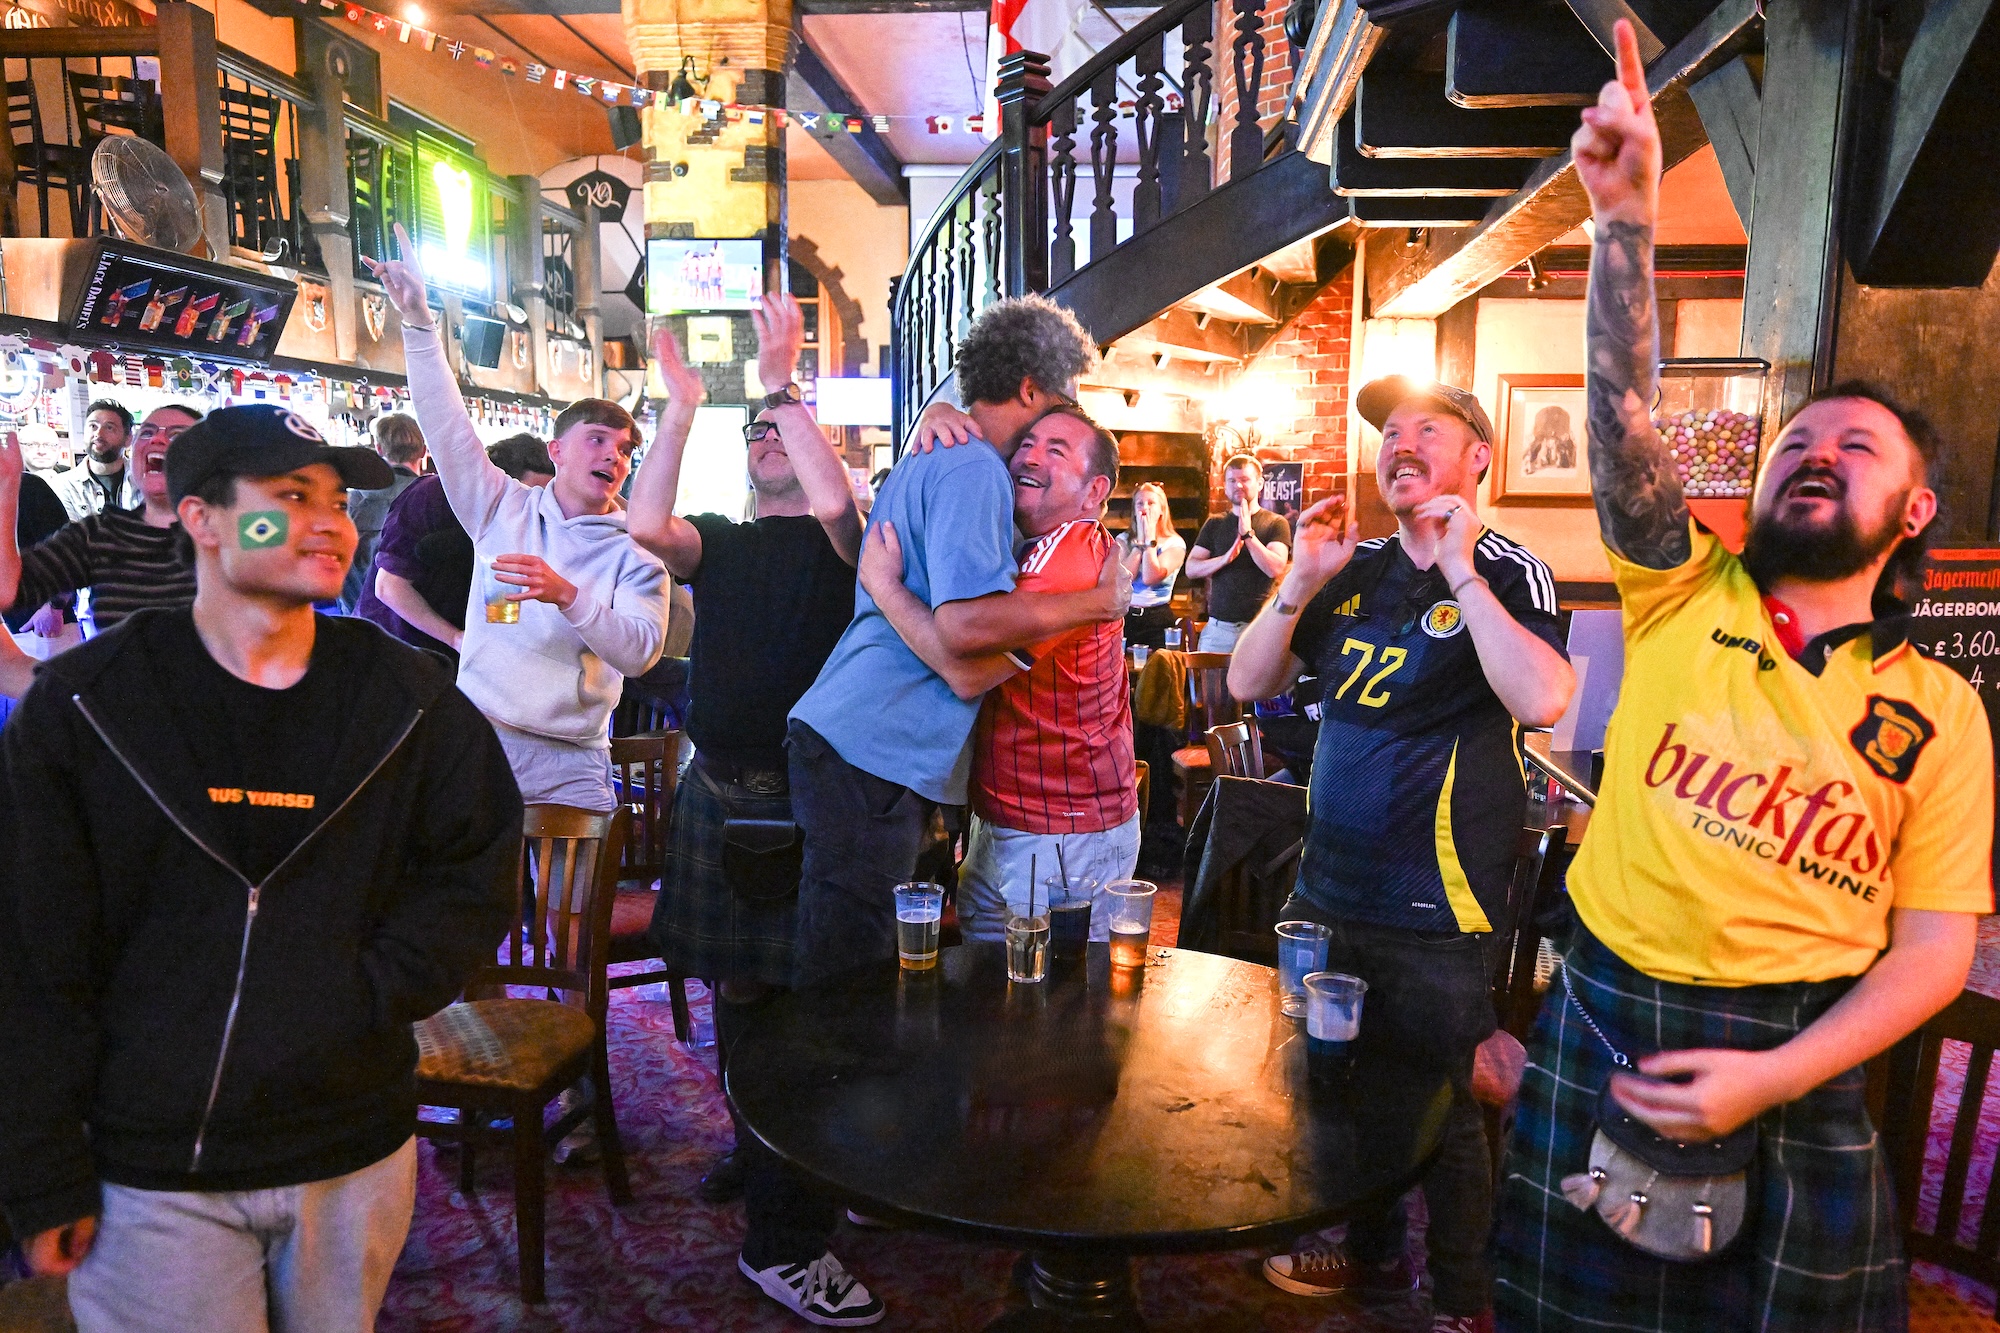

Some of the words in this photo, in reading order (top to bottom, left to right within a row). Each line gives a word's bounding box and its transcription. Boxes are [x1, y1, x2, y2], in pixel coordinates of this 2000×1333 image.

[1263, 480, 1297, 501] BEAST
[1335, 637, 1408, 708] 72
[1711, 628, 1777, 671] UMBO
[1692, 811, 1776, 859] TONIC
[1799, 856, 1879, 904] WINE
